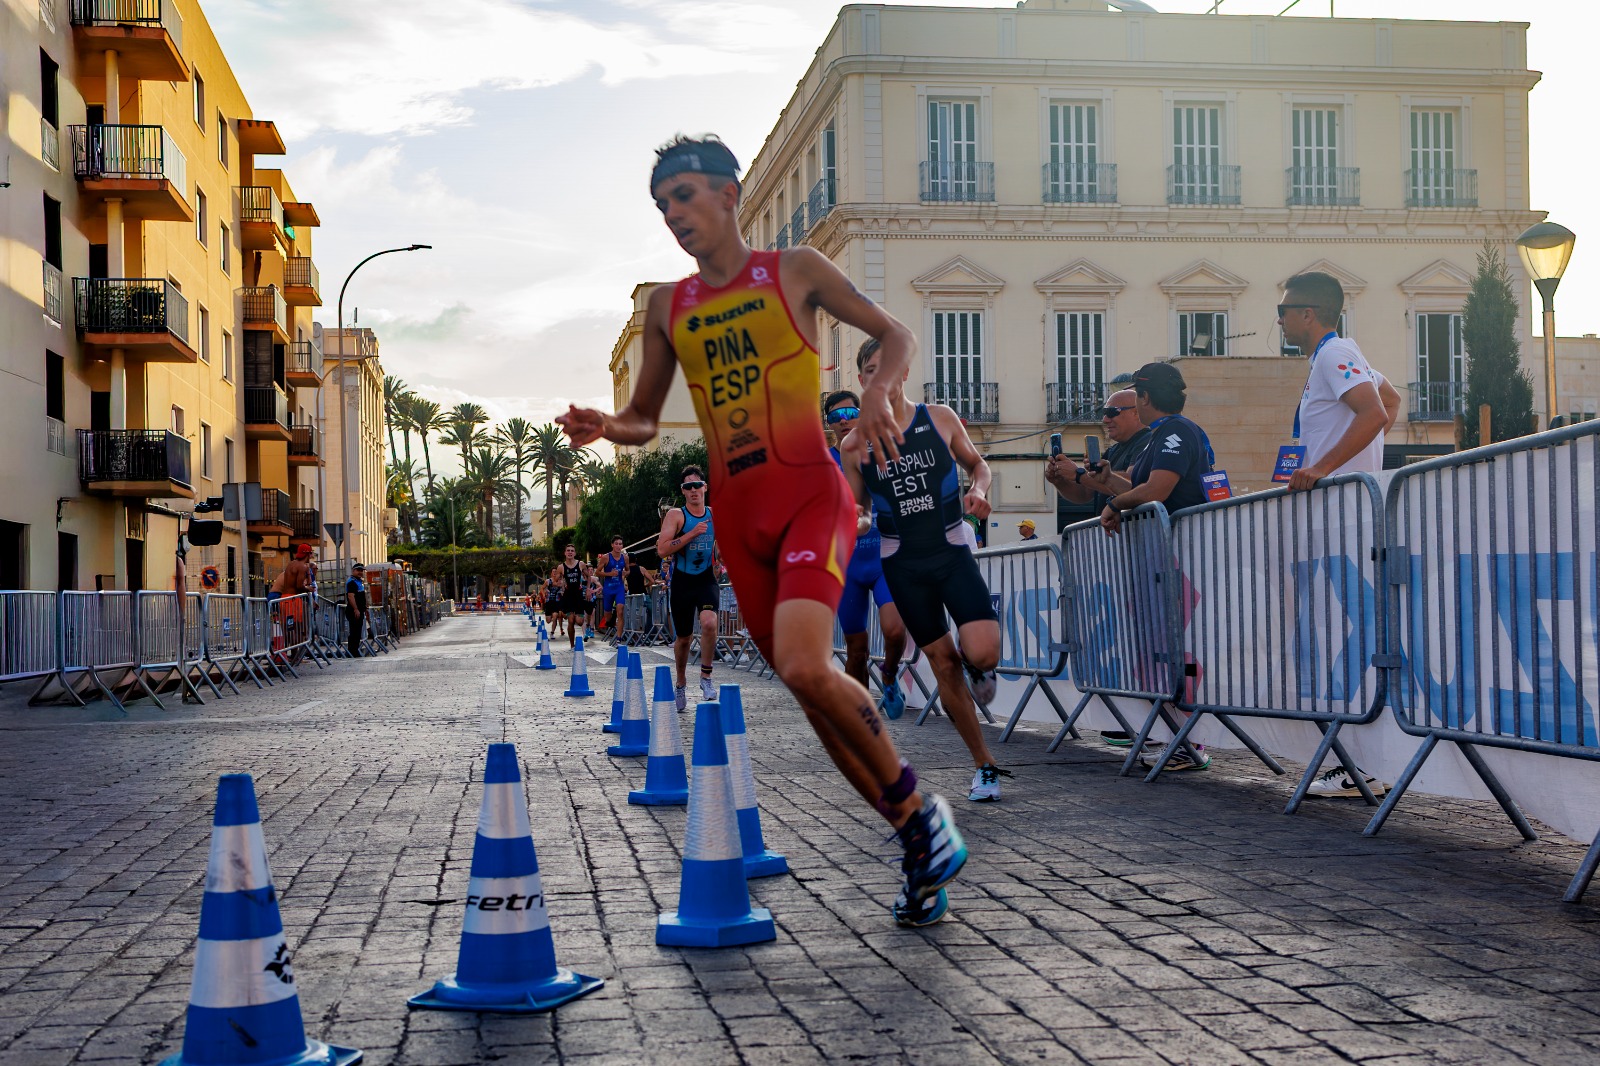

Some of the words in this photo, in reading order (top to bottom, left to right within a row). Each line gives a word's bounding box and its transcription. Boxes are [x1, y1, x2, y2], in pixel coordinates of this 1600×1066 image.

[704, 298, 765, 327] SUZUKI
[704, 327, 759, 371] PIÑA
[711, 365, 761, 408] ESP
[876, 448, 936, 481] METSPALU
[892, 472, 928, 497] EST
[899, 494, 933, 508] PRING
[900, 501, 935, 516] STORE
[689, 542, 711, 551] BEL
